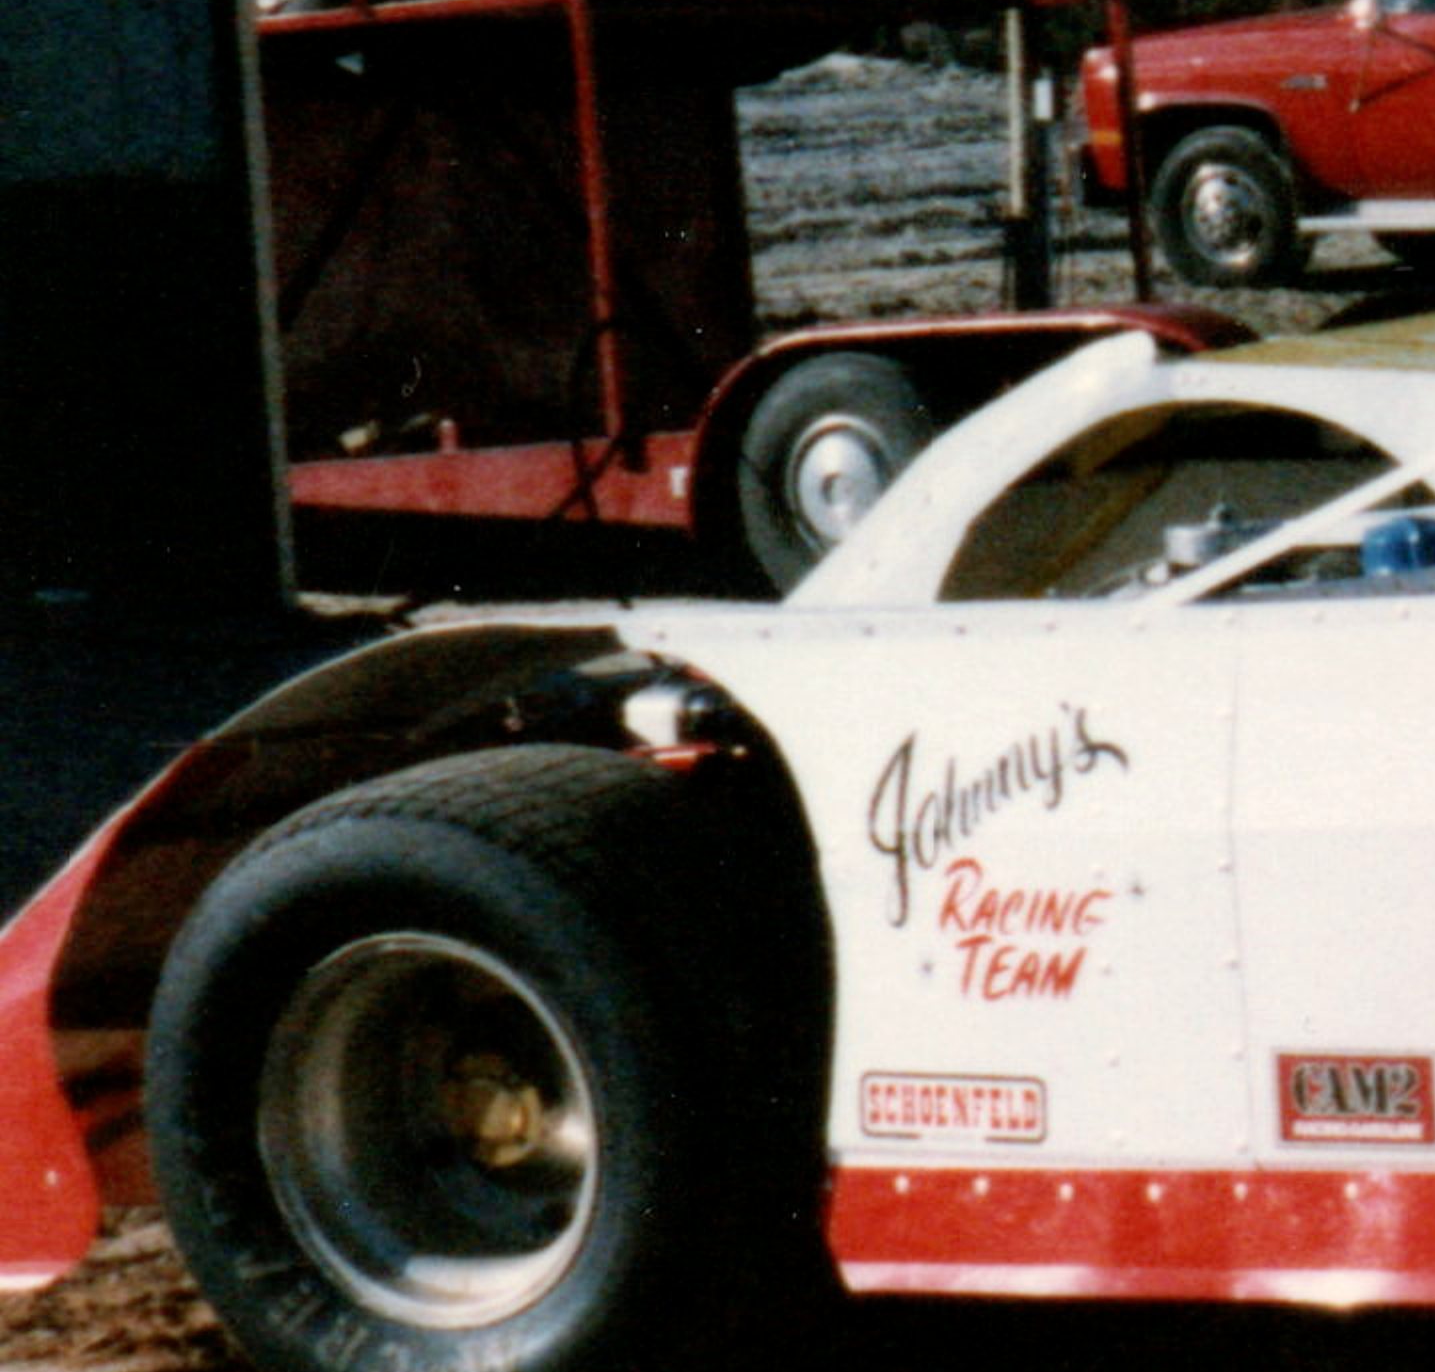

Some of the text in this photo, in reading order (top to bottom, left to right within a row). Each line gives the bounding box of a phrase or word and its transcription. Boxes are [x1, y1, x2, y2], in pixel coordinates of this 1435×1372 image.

[867, 700, 1129, 929] Johnny's
[938, 857, 1113, 937] RACING
[955, 934, 1087, 1001] TEAM
[867, 1084, 1039, 1130] SCHOENFELD
